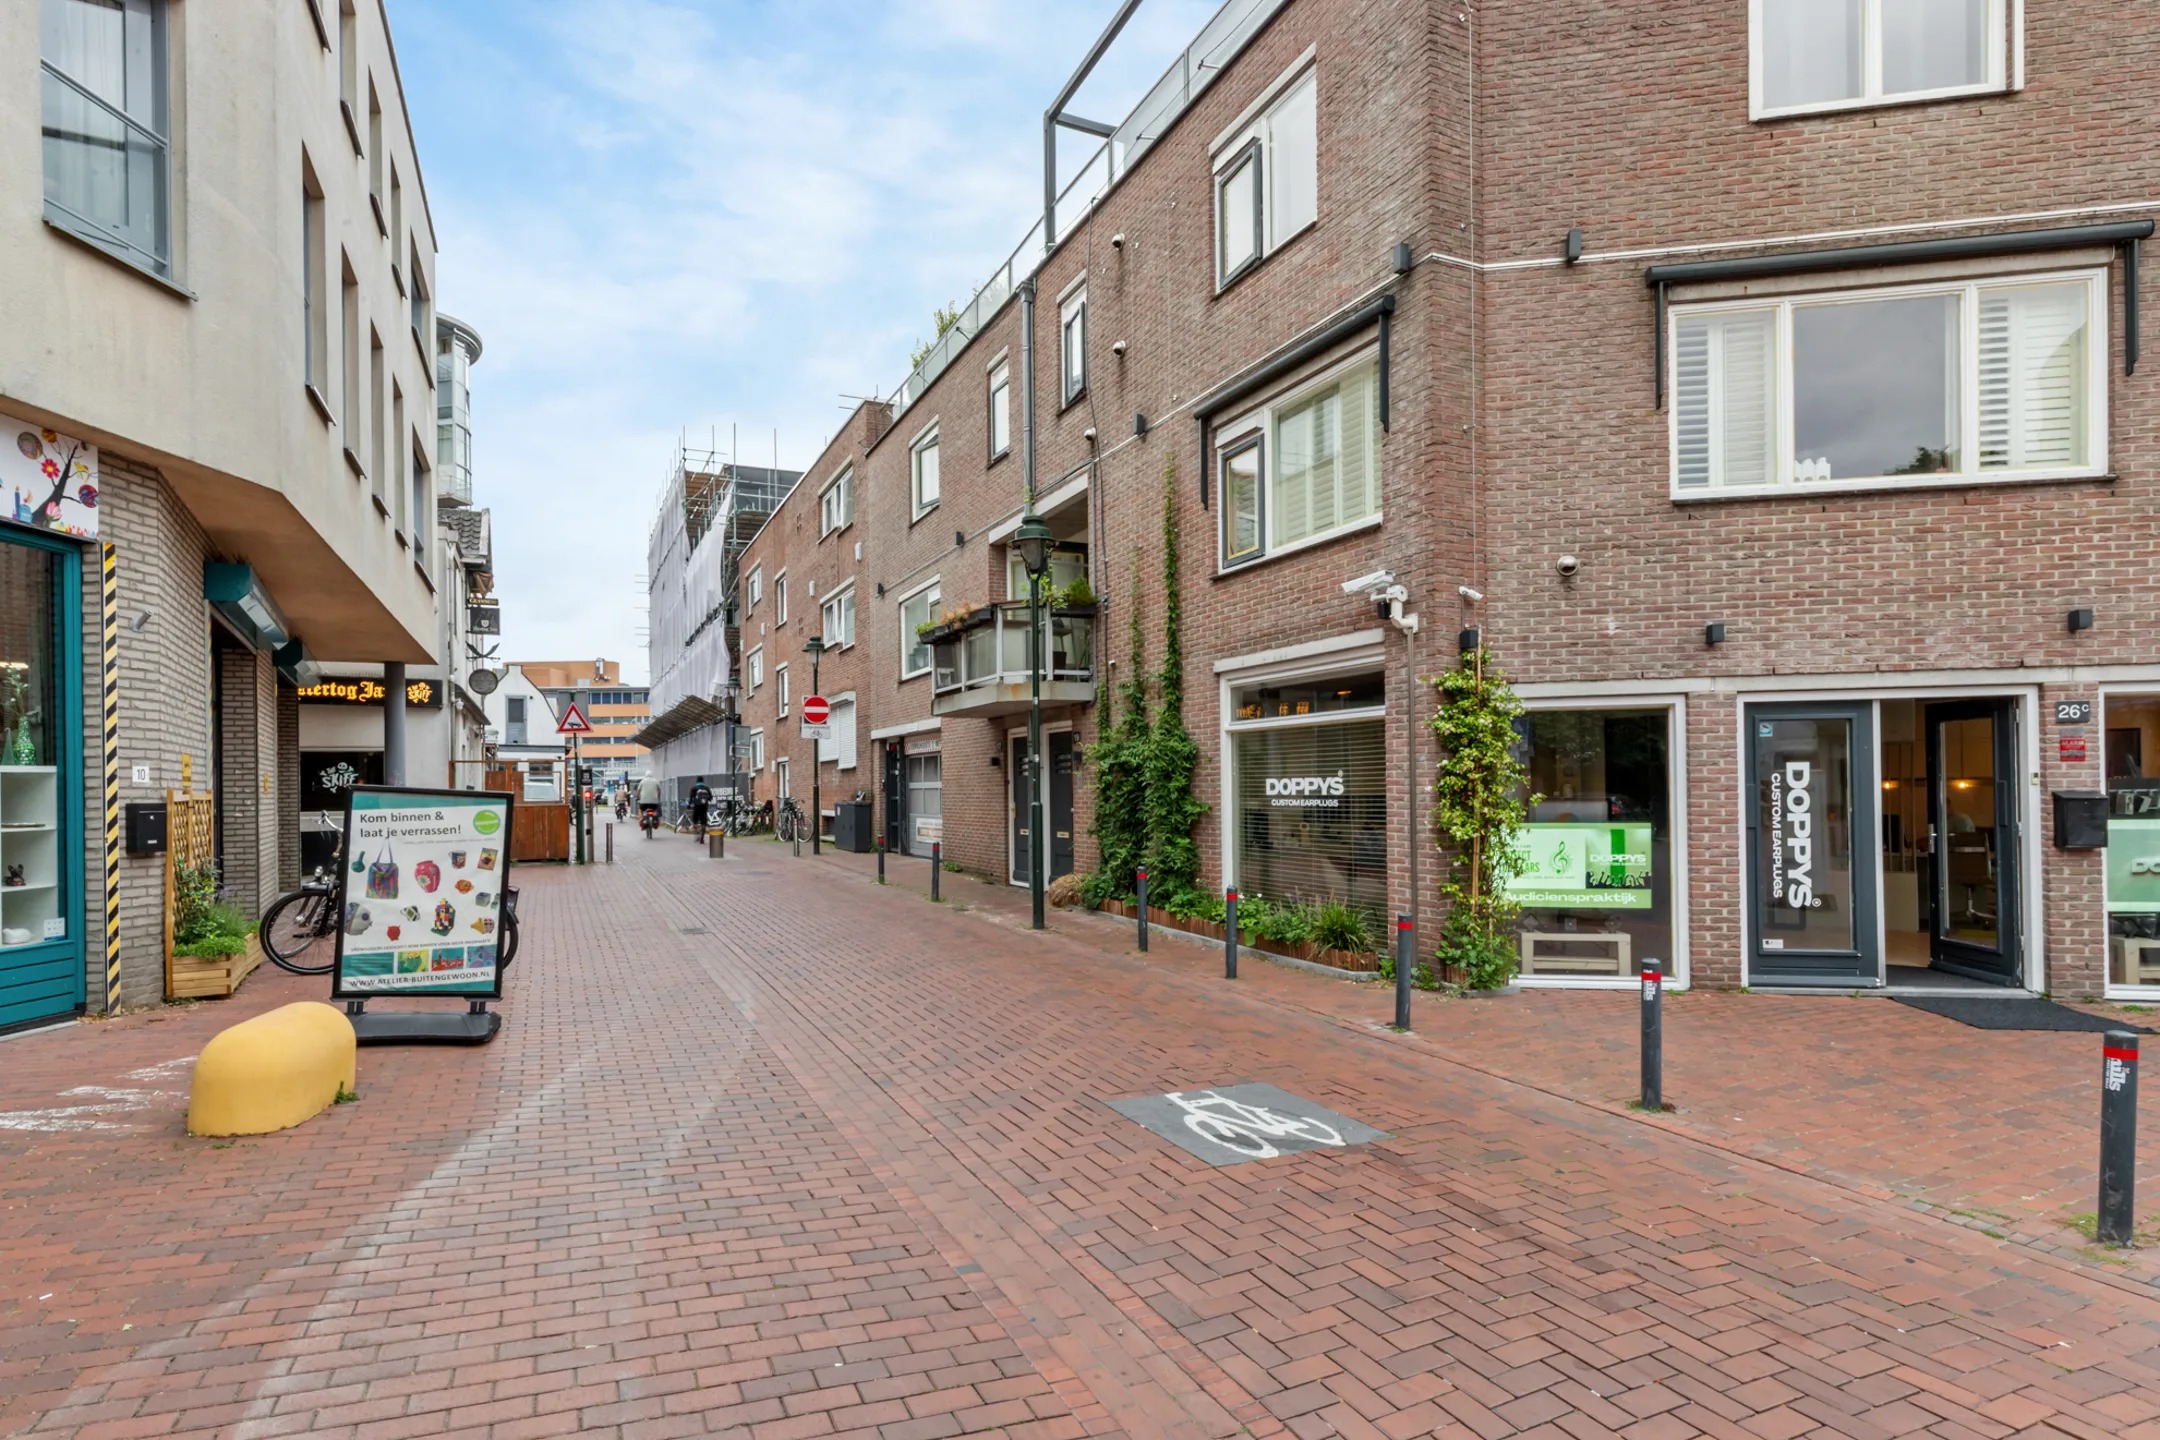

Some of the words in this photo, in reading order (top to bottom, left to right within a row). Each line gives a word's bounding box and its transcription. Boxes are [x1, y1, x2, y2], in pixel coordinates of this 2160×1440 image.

[137, 769, 146, 780] 10
[1265, 777, 1345, 795] DOPPYS
[1301, 799, 1339, 807] EARPLUGS
[1771, 773, 1781, 828] CUSTOM
[360, 813, 387, 823] Kom
[391, 812, 431, 822] binnen
[435, 811, 444, 821] &
[360, 828, 383, 838] laat
[386, 828, 397, 838] je
[400, 825, 461, 837] verrassen!
[1786, 761, 1812, 908] DOPPYS
[1772, 831, 1783, 898] EARPLUGS
[1503, 891, 1637, 904] Audicienspraktijk
